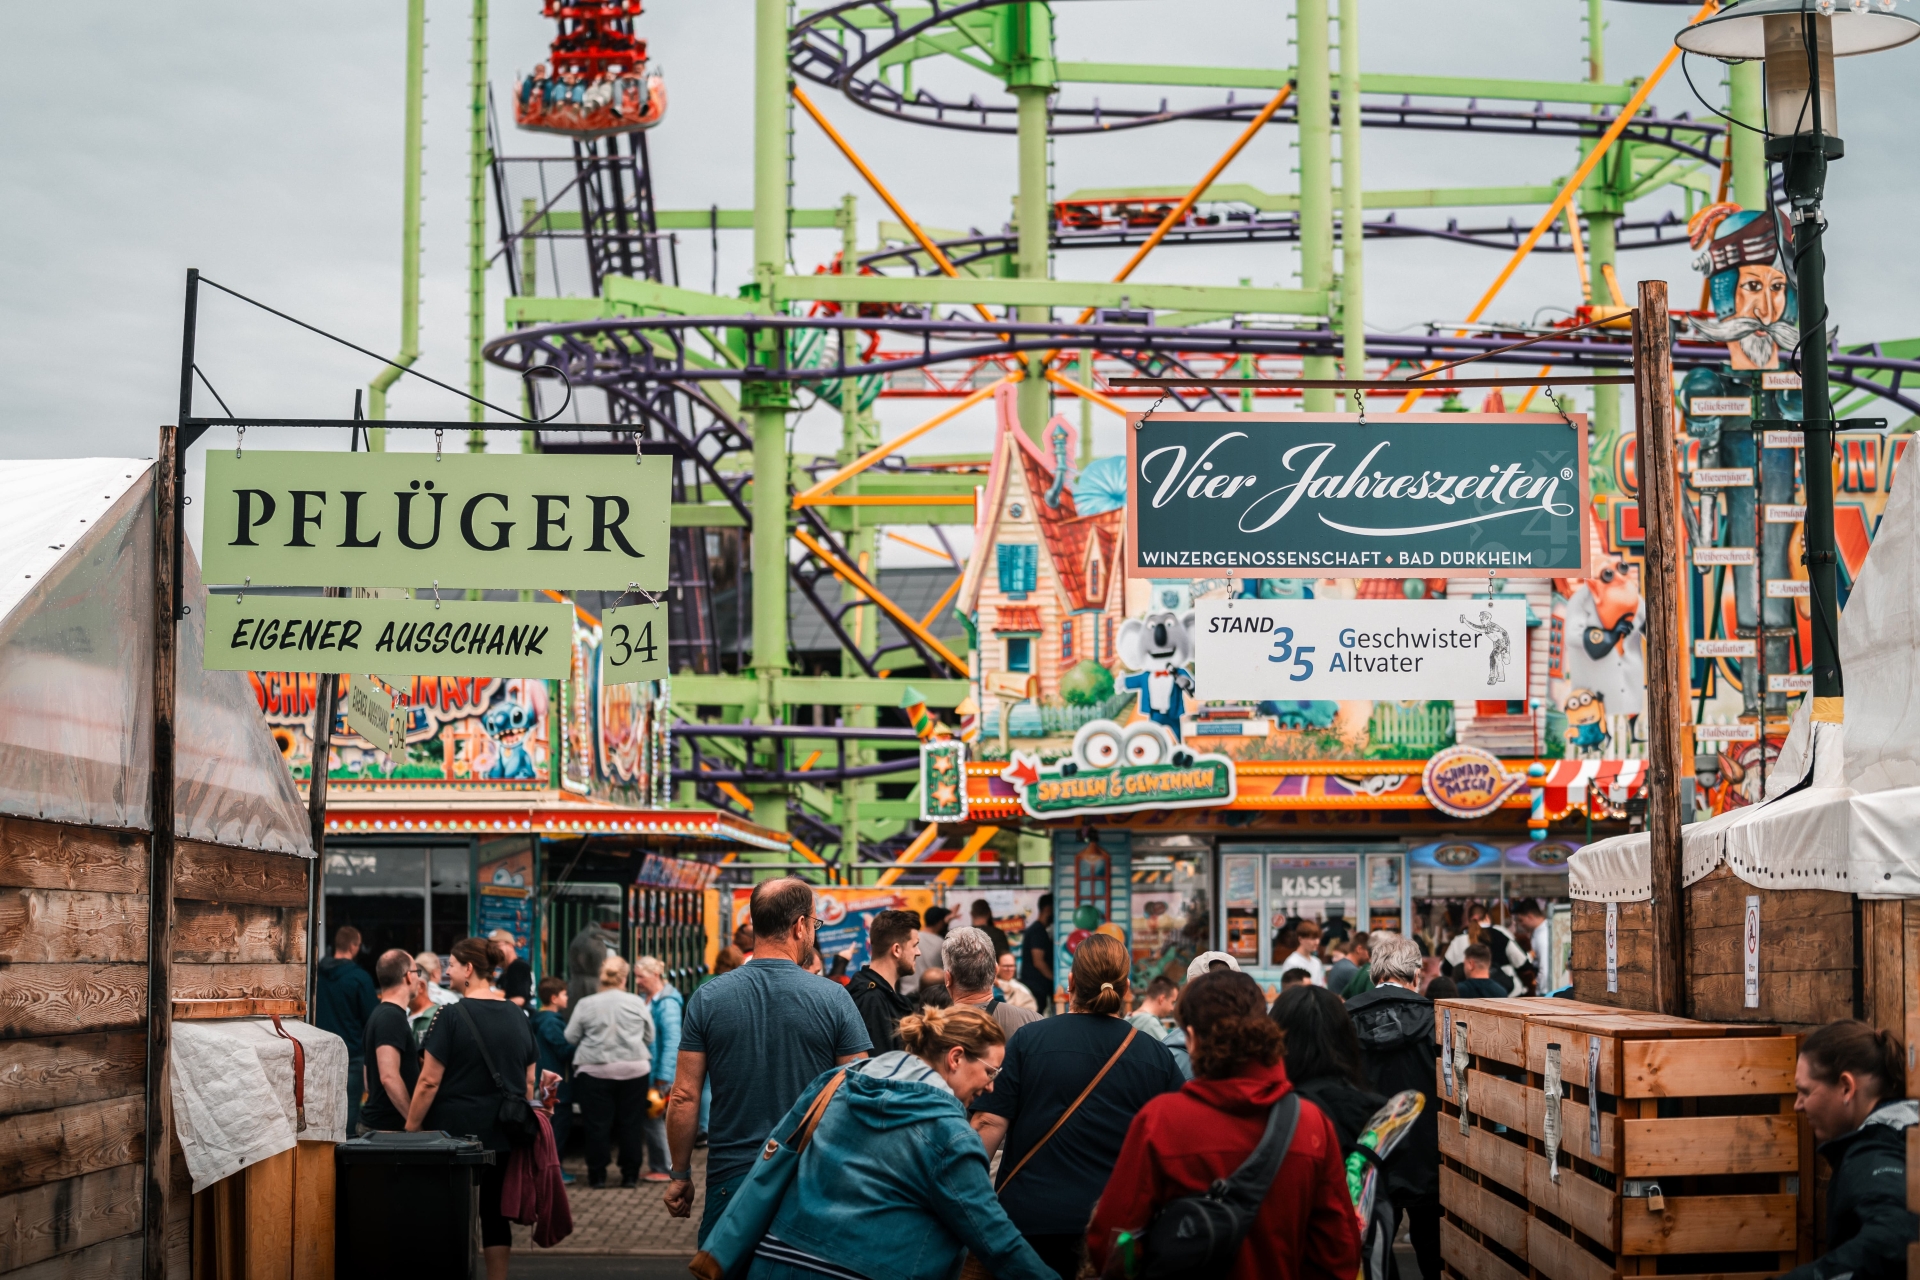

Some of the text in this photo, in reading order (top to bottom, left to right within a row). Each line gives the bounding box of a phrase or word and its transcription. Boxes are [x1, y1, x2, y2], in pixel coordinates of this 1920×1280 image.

[1142, 431, 1257, 509] Vier
[228, 480, 645, 558] PFLÜGER
[1143, 551, 1532, 566] WINZERGENOSSENSCHAFT BAD DÜRKHEIM
[231, 618, 549, 656] EIGENER AUSSCHANK
[609, 620, 659, 667] 34
[1208, 616, 1316, 682] STAND 35
[1338, 627, 1483, 649] Geschwister
[1706, 643, 1745, 654] Gladiator
[1328, 651, 1424, 673] Altvater
[1038, 776, 1108, 802] SPIELEN
[1124, 769, 1215, 794] GEWINNEN
[1436, 763, 1490, 788] SCHNAPP
[1445, 777, 1496, 798] MICH!
[1281, 875, 1343, 897] KASSE
